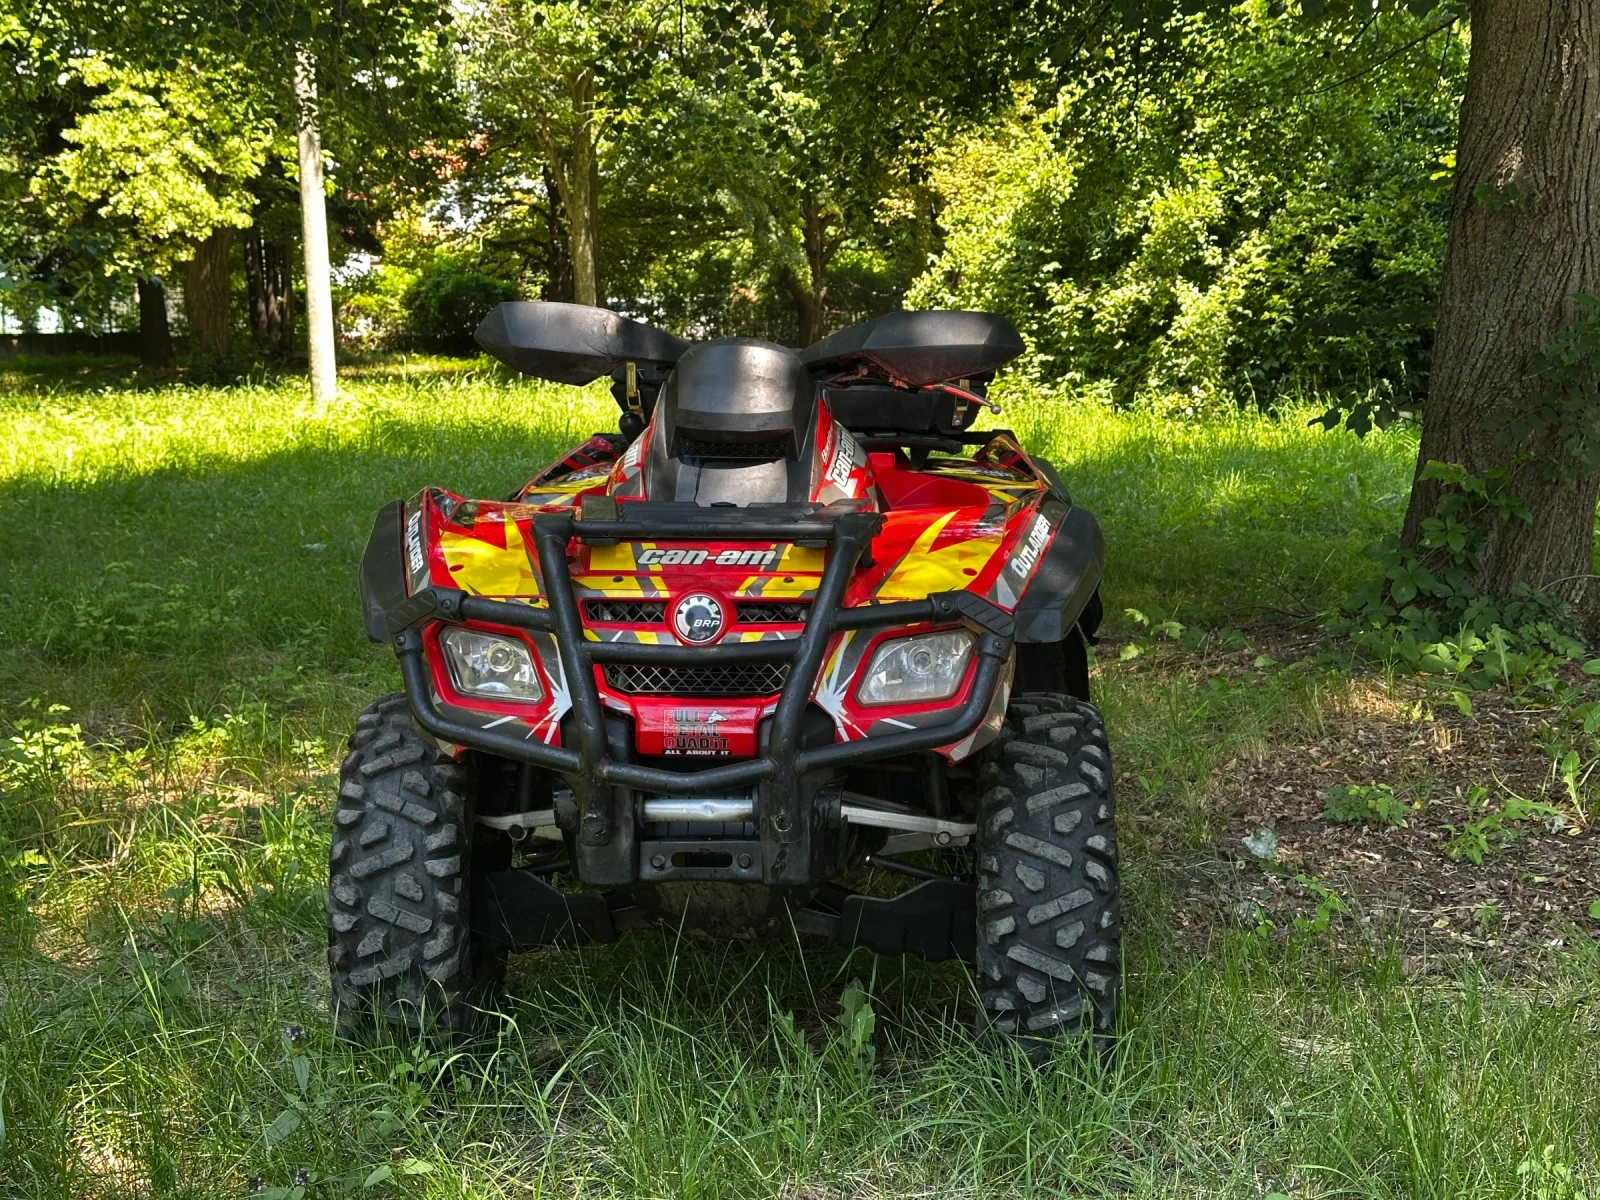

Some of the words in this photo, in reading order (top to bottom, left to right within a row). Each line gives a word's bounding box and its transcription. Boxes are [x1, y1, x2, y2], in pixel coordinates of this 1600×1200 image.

[408, 510, 424, 575] OUTLANDER
[1010, 513, 1051, 579] OUTLANDER
[637, 549, 777, 565] can-am
[693, 619, 721, 628] BRP
[663, 709, 702, 723] FULL
[663, 723, 720, 737] METAL
